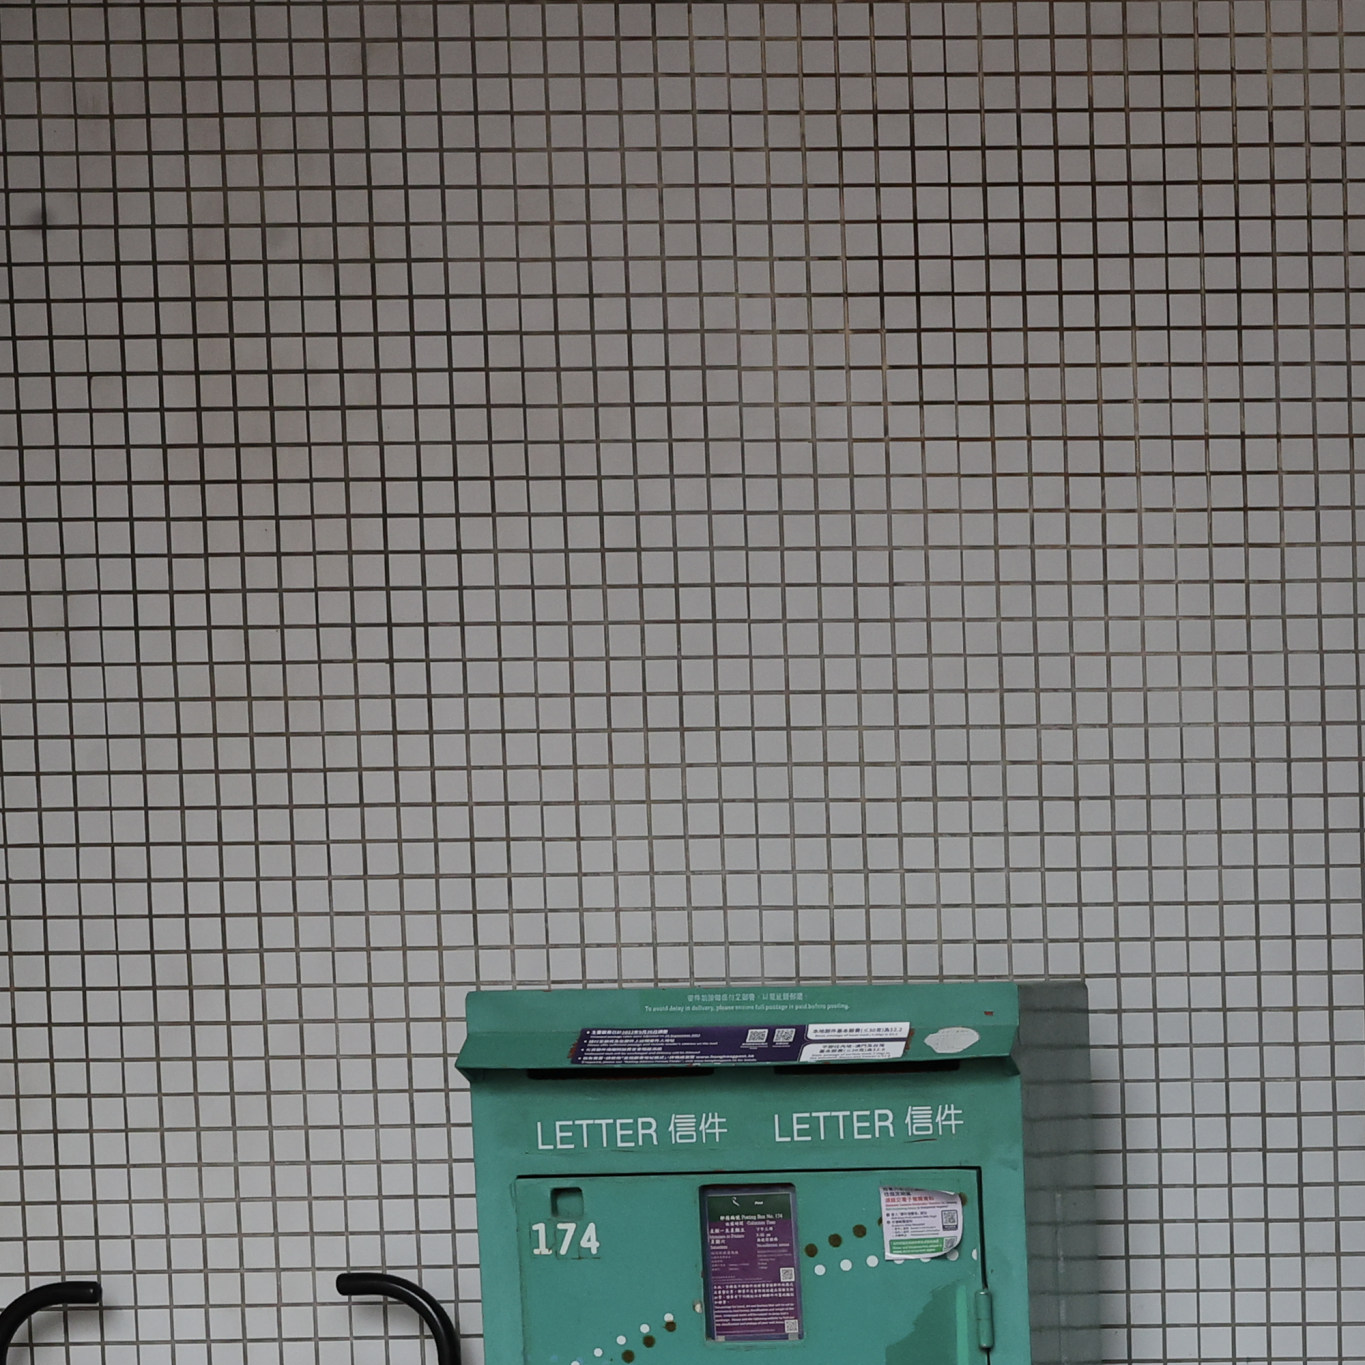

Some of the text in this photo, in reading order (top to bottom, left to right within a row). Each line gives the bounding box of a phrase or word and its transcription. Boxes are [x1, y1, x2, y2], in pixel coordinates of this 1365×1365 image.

[537, 1112, 728, 1150] LETTER 信件
[774, 1104, 964, 1142] LETTER 信件
[531, 1222, 600, 1255] 174
